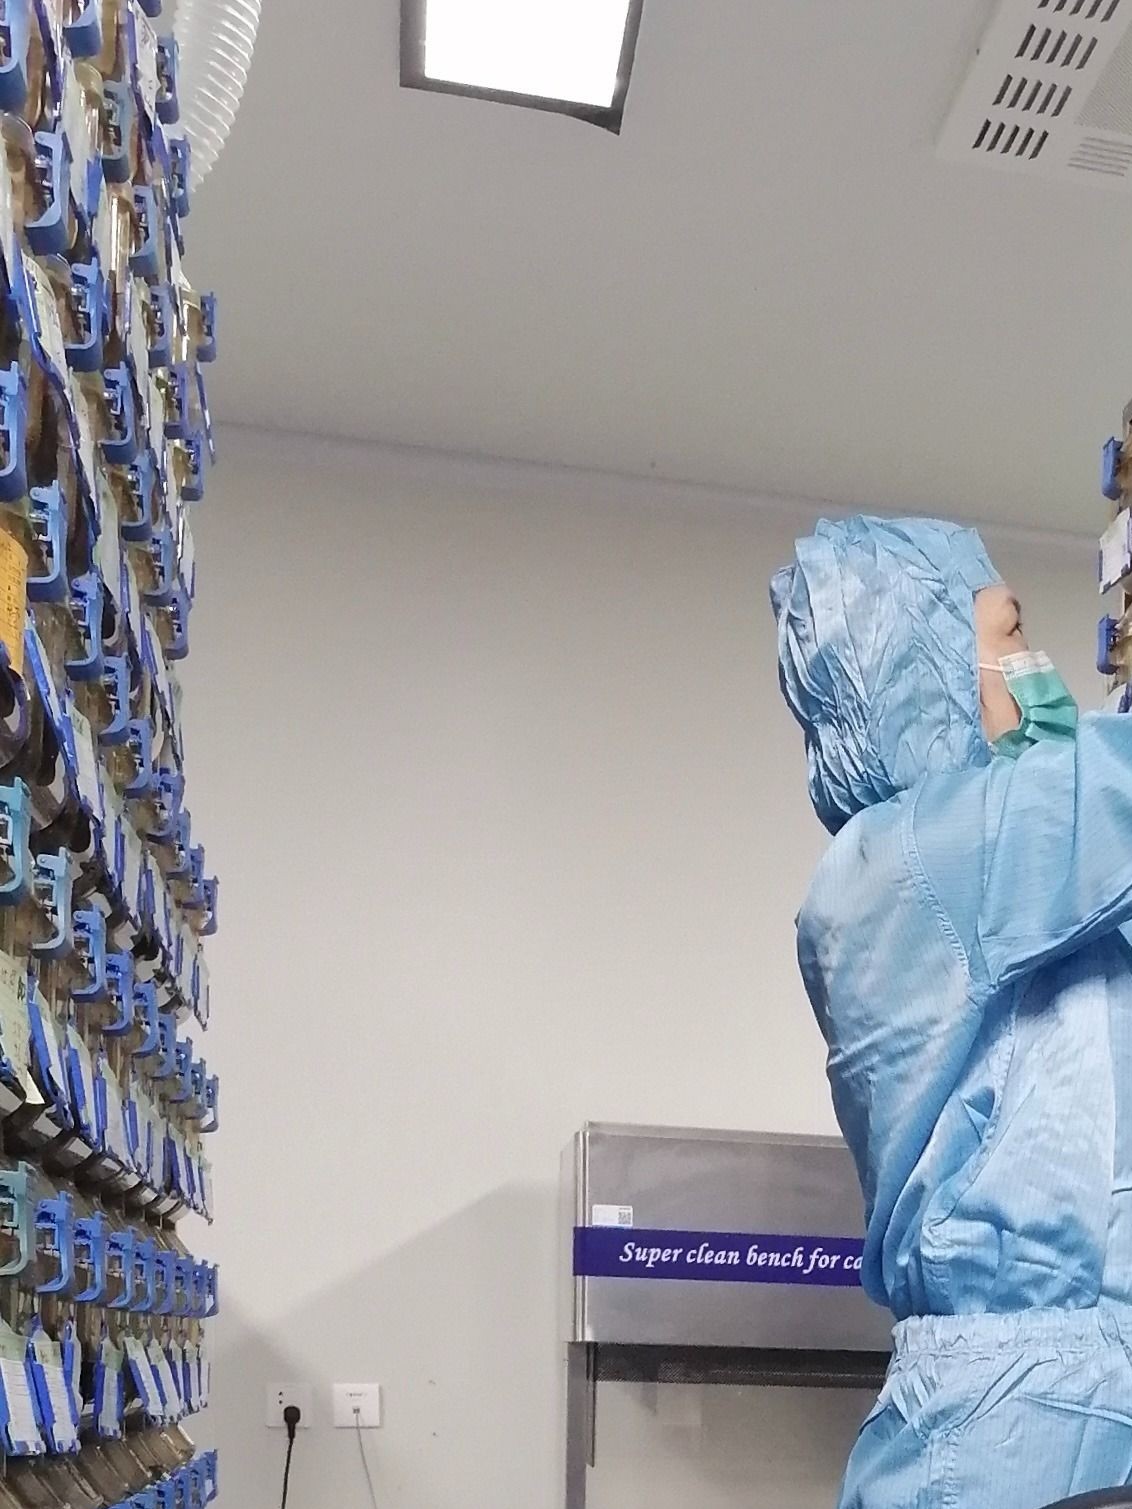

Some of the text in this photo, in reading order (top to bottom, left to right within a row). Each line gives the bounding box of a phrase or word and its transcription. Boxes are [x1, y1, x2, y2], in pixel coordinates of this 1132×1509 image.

[619, 1242, 683, 1268] Super
[686, 1243, 740, 1266] clean
[746, 1245, 804, 1267] bench
[803, 1247, 841, 1274] for
